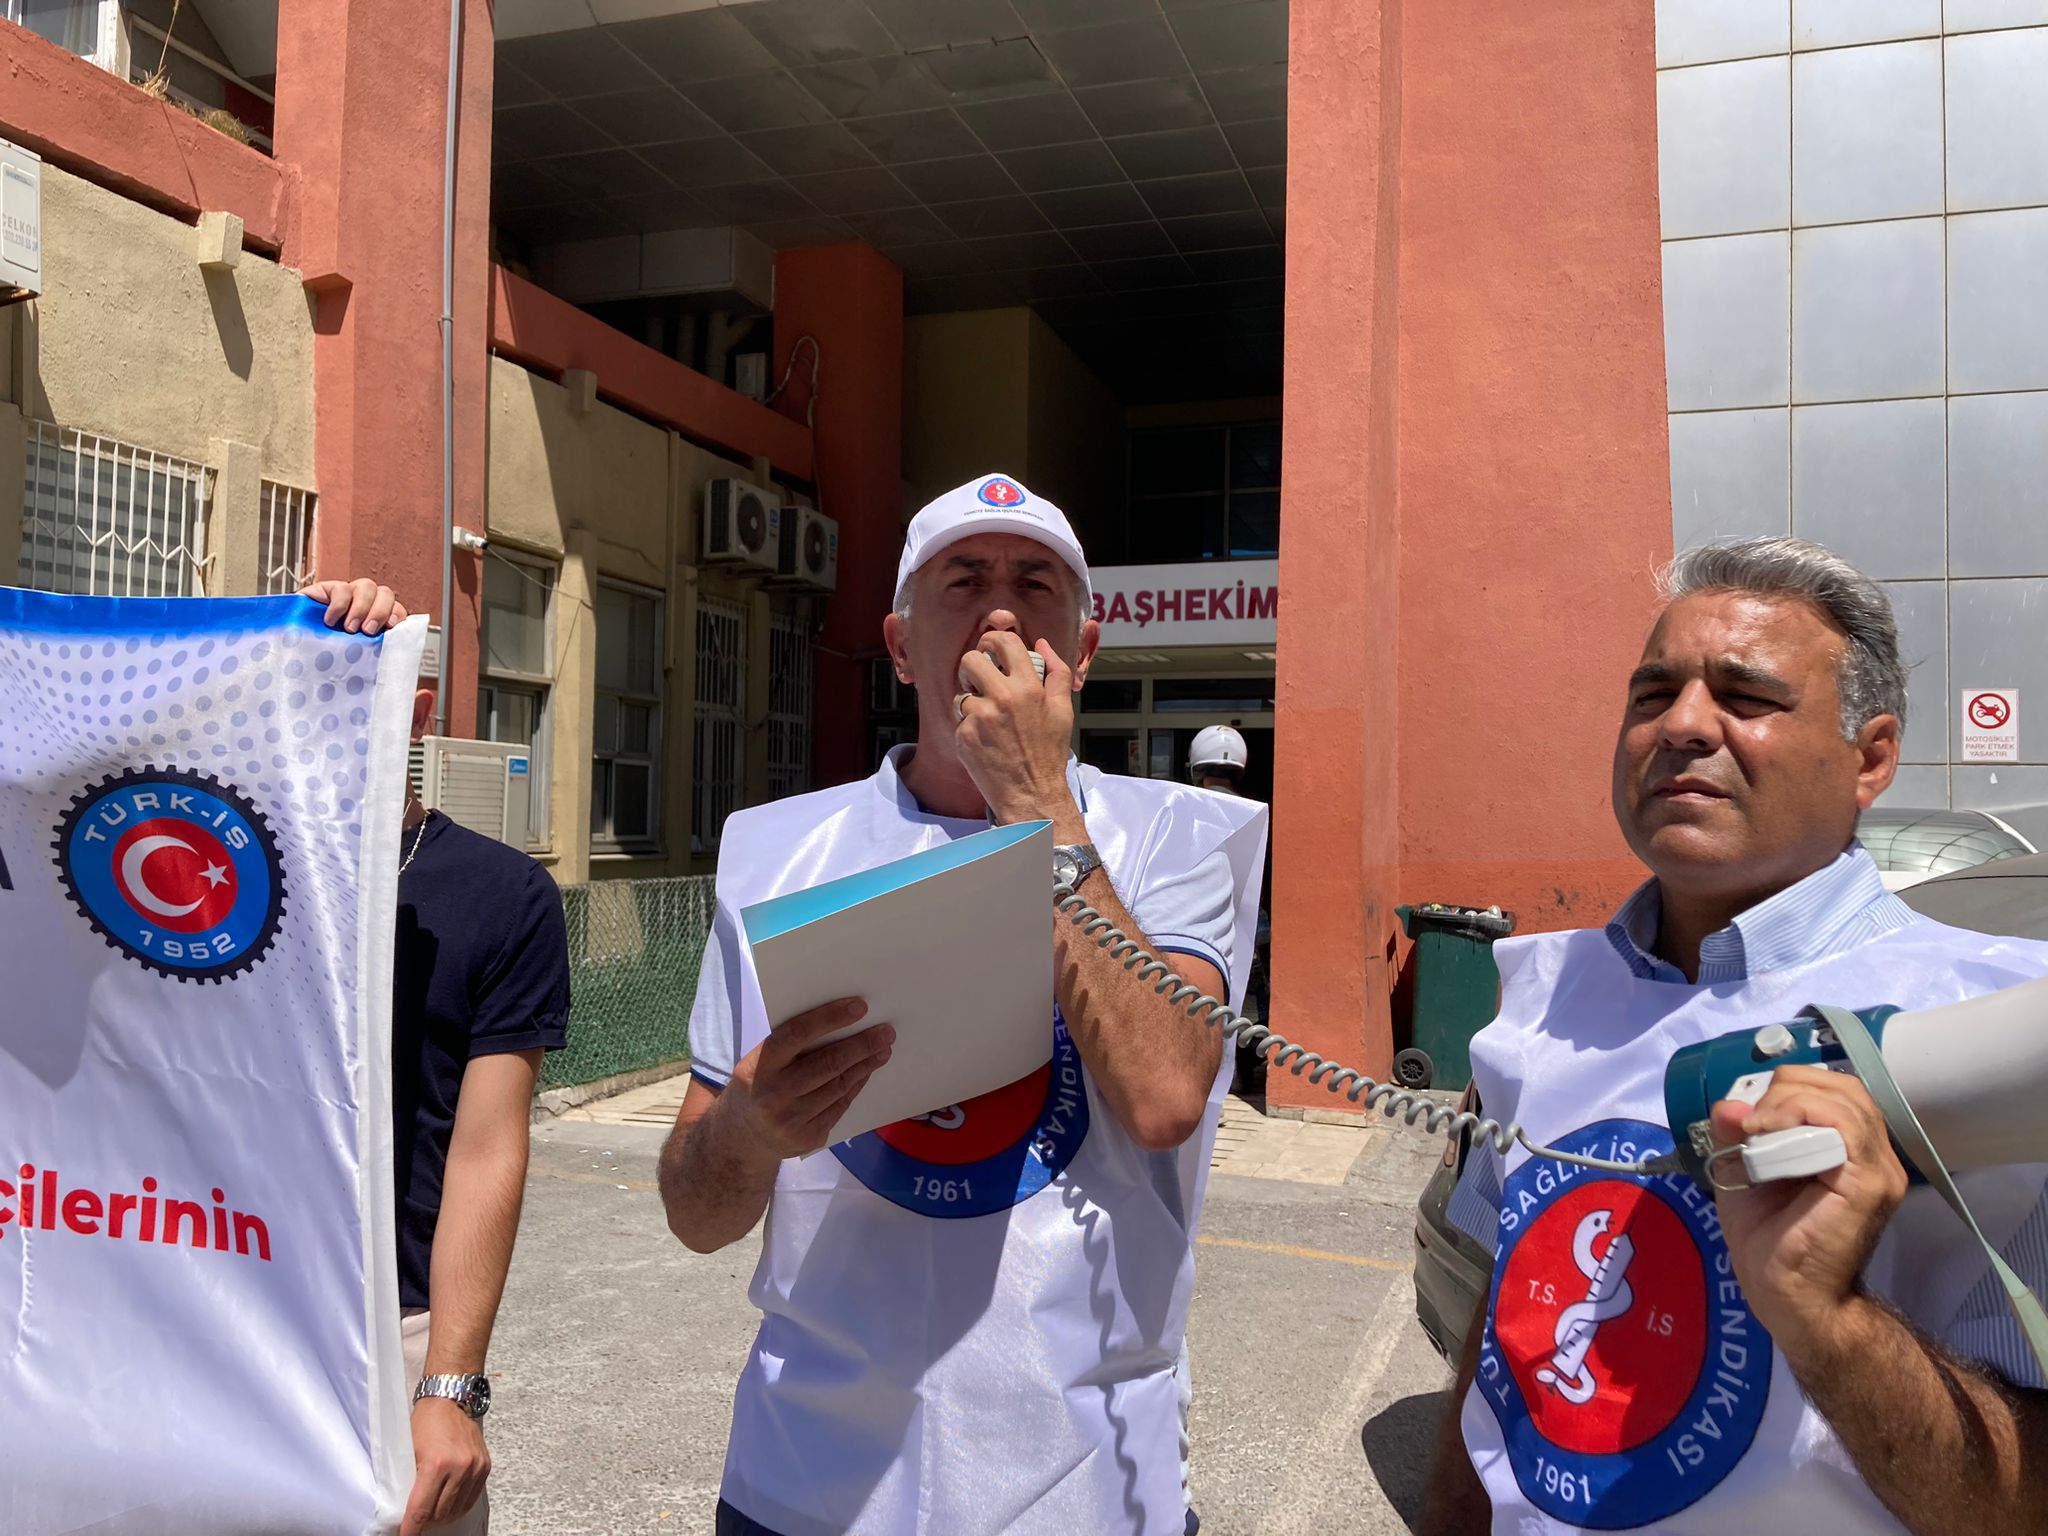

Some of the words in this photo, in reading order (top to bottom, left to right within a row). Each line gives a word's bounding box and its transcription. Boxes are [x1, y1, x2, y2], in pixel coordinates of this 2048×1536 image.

[84, 793, 249, 850] TÜRK-İŞ
[139, 930, 236, 960] 1952
[913, 1175, 973, 1202] 1961
[1528, 1279, 1558, 1306] T.S.
[1666, 1253, 1751, 1476] SENDİKASI
[1534, 1455, 1592, 1505] 1961
